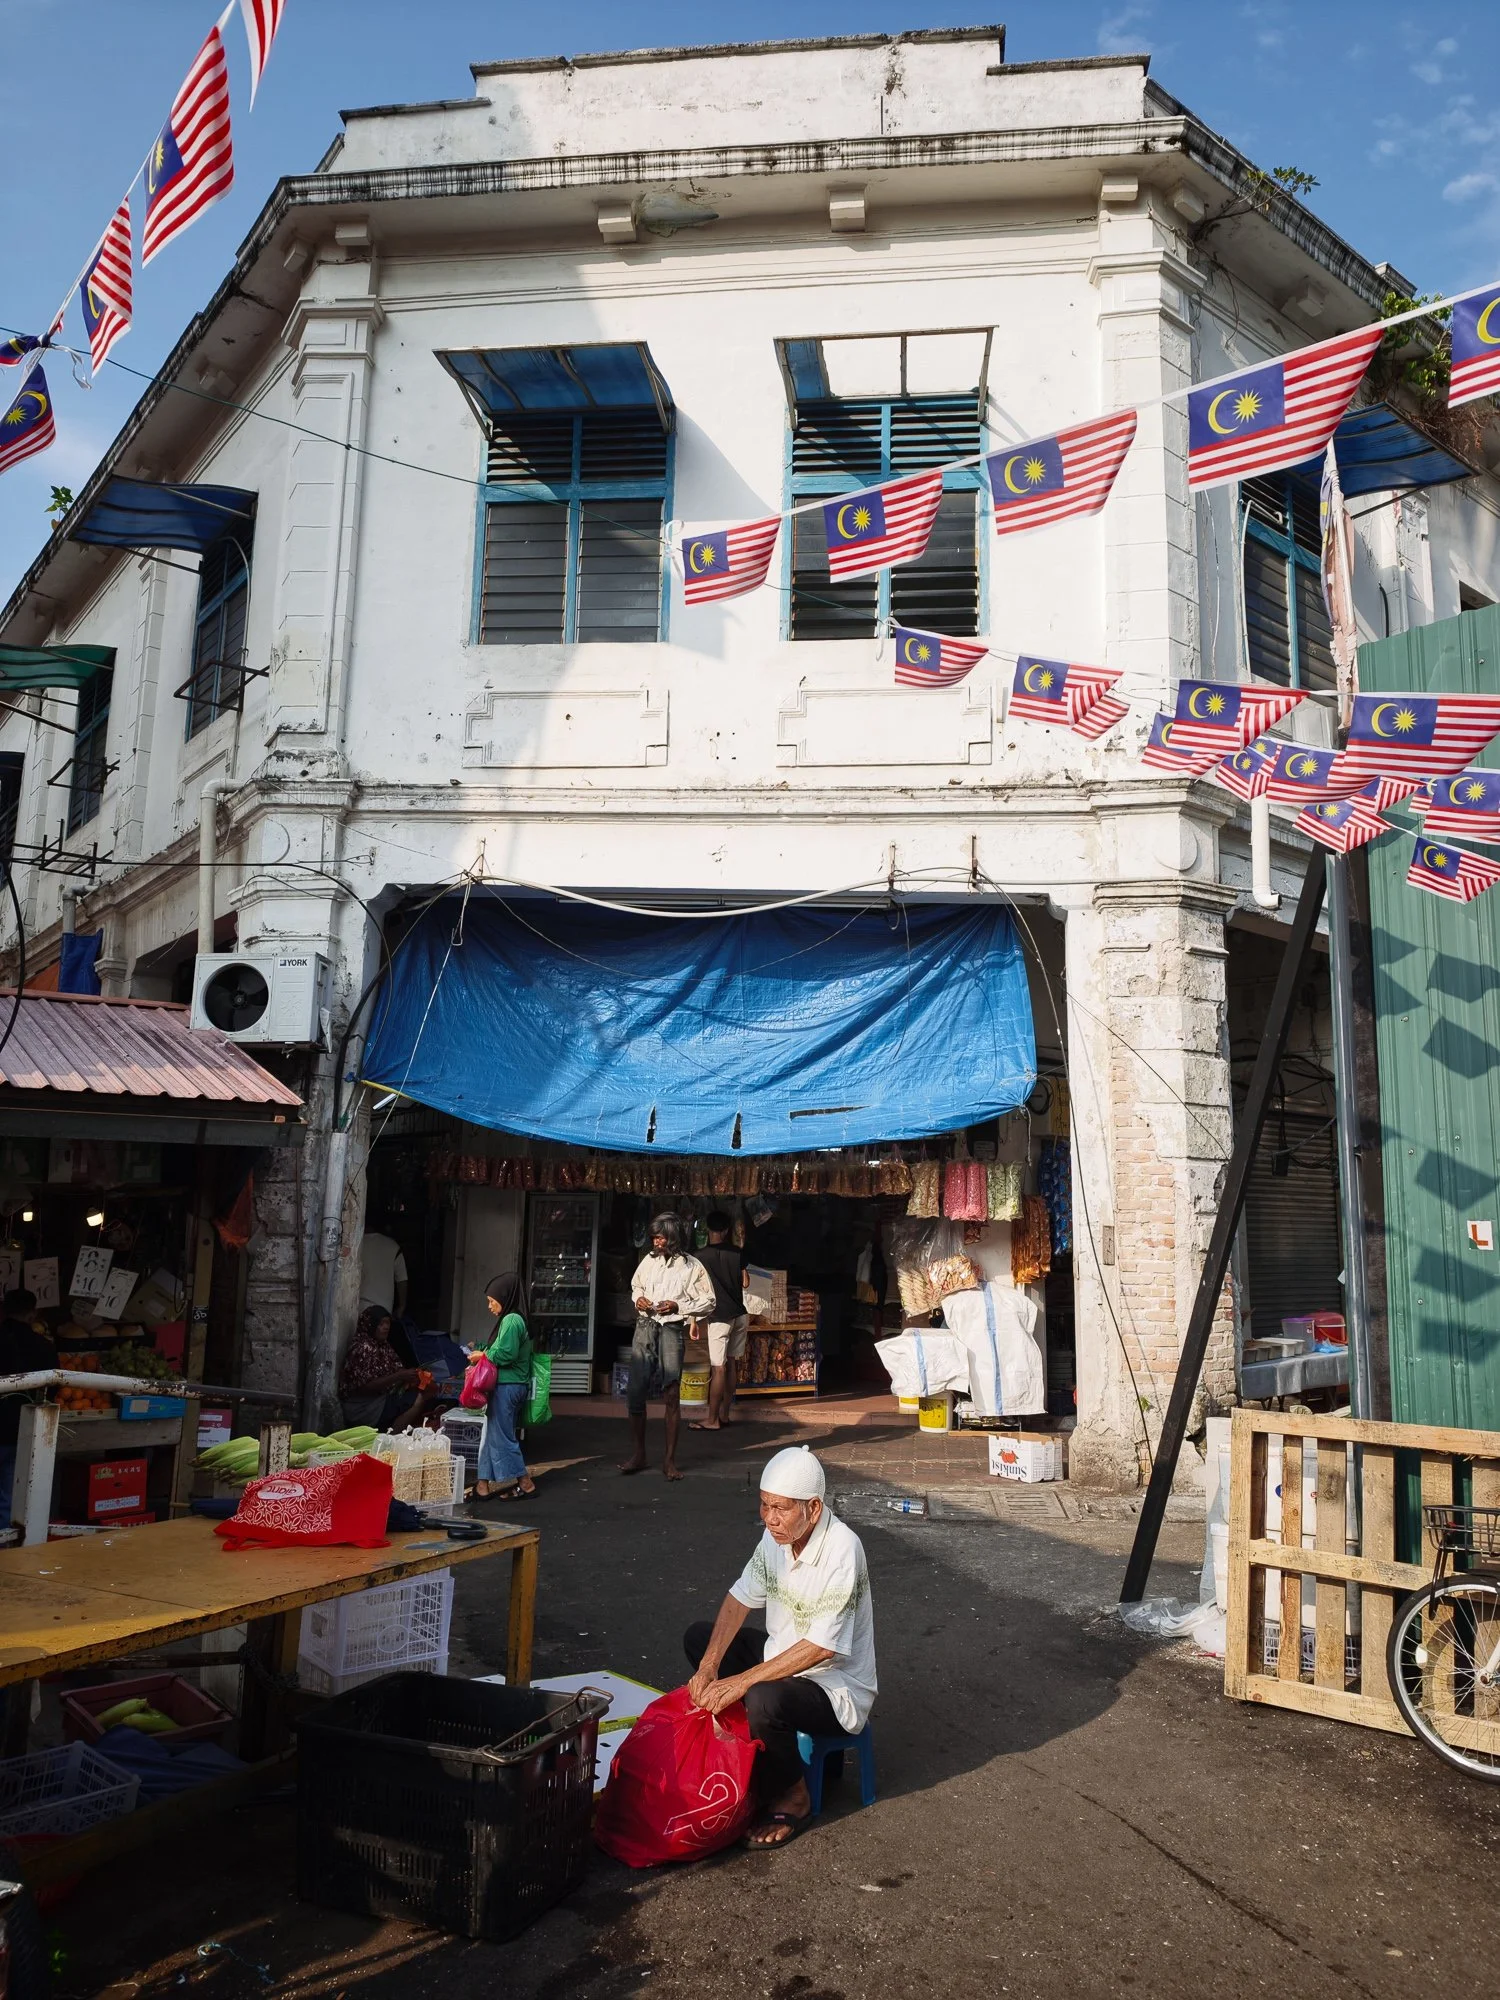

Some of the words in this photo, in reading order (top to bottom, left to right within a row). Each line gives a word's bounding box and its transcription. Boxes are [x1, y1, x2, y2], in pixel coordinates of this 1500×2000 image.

[287, 959, 308, 967] YORK
[1471, 1224, 1489, 1246] L
[81, 1276, 98, 1292] 10
[37, 1286, 54, 1300] 10
[104, 1295, 121, 1309] 10
[992, 1459, 1027, 1478] Sunkist
